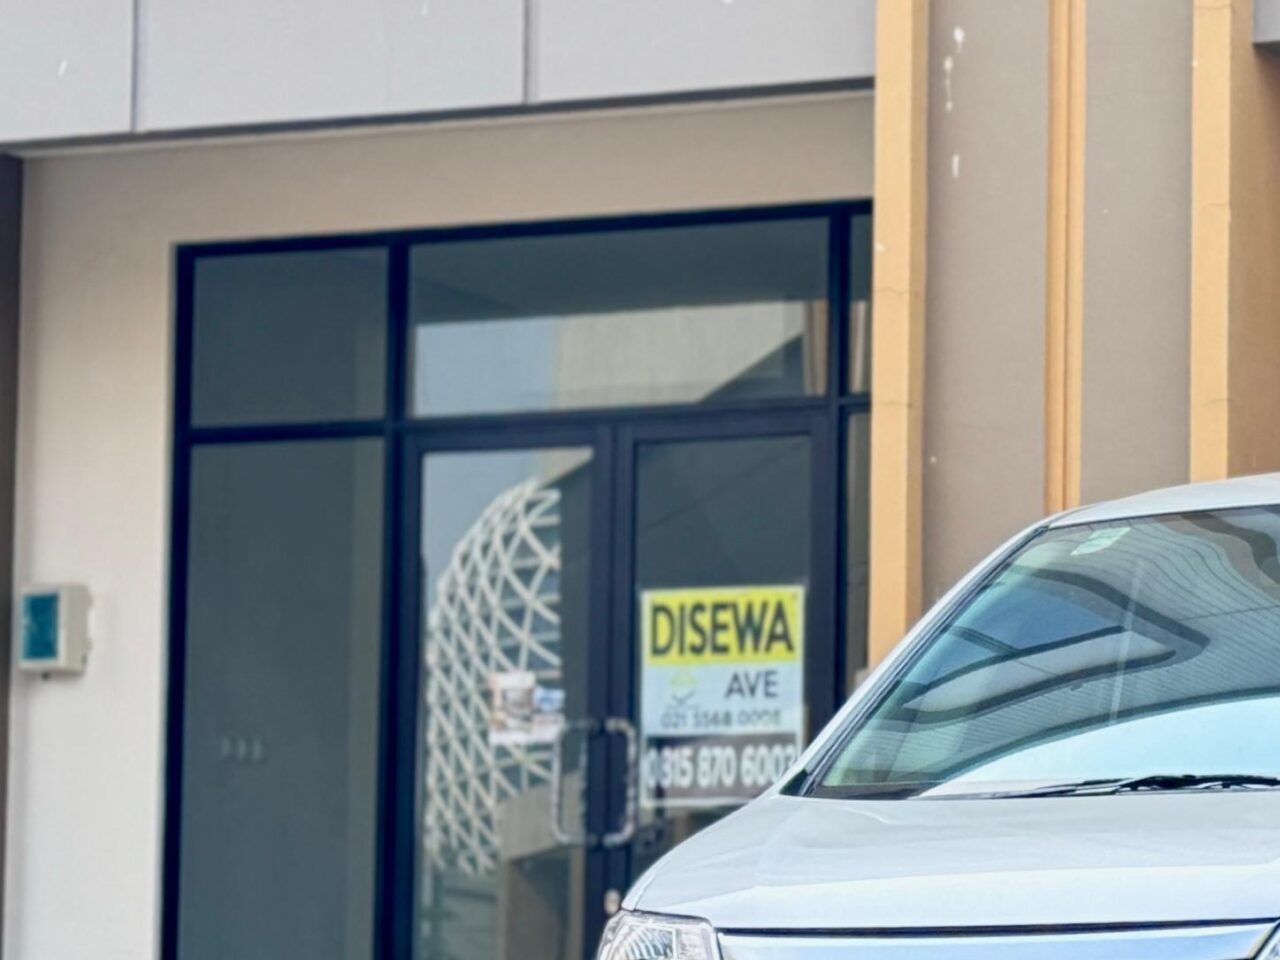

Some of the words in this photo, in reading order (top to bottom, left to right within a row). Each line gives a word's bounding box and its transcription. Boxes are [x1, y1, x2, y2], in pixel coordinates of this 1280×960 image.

[652, 601, 794, 656] DISEWA
[725, 670, 778, 698] AVE
[697, 745, 737, 788] 870
